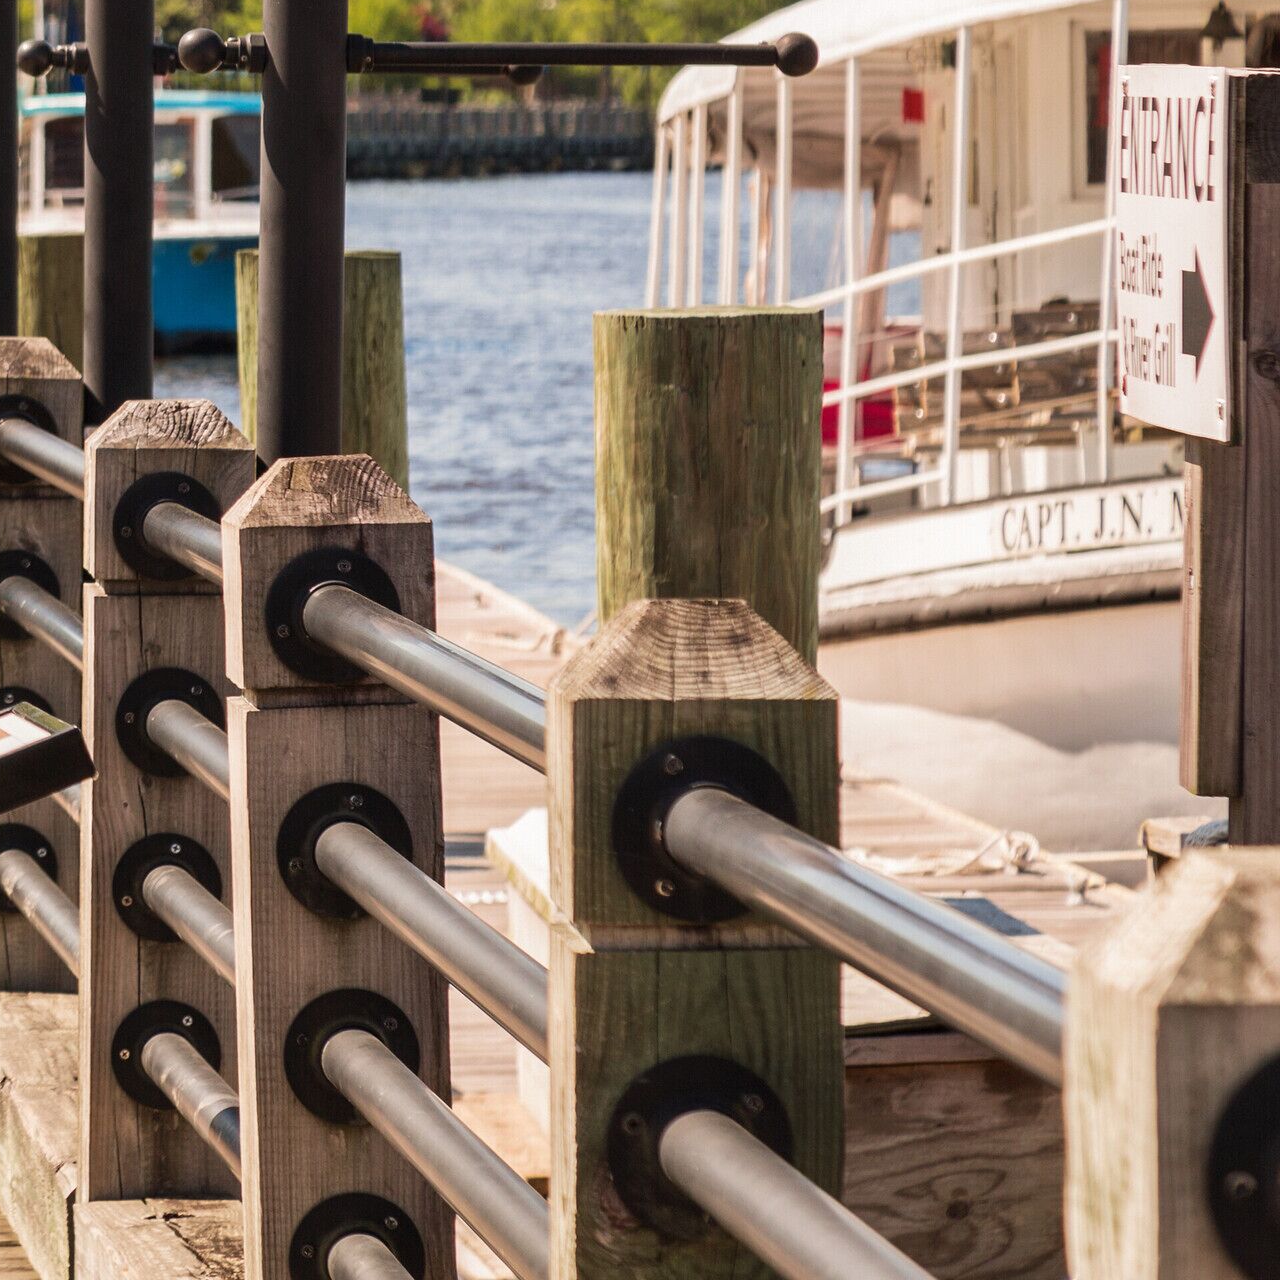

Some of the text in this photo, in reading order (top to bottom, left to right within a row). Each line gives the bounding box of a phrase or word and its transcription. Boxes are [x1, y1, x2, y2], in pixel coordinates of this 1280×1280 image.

[1120, 95, 1216, 203] ENTRANCE
[1120, 231, 1164, 300] Boat Ride
[1154, 322, 1177, 388] Grill
[1001, 500, 1081, 551] CAPT.
[1094, 490, 1153, 539] J.N.
